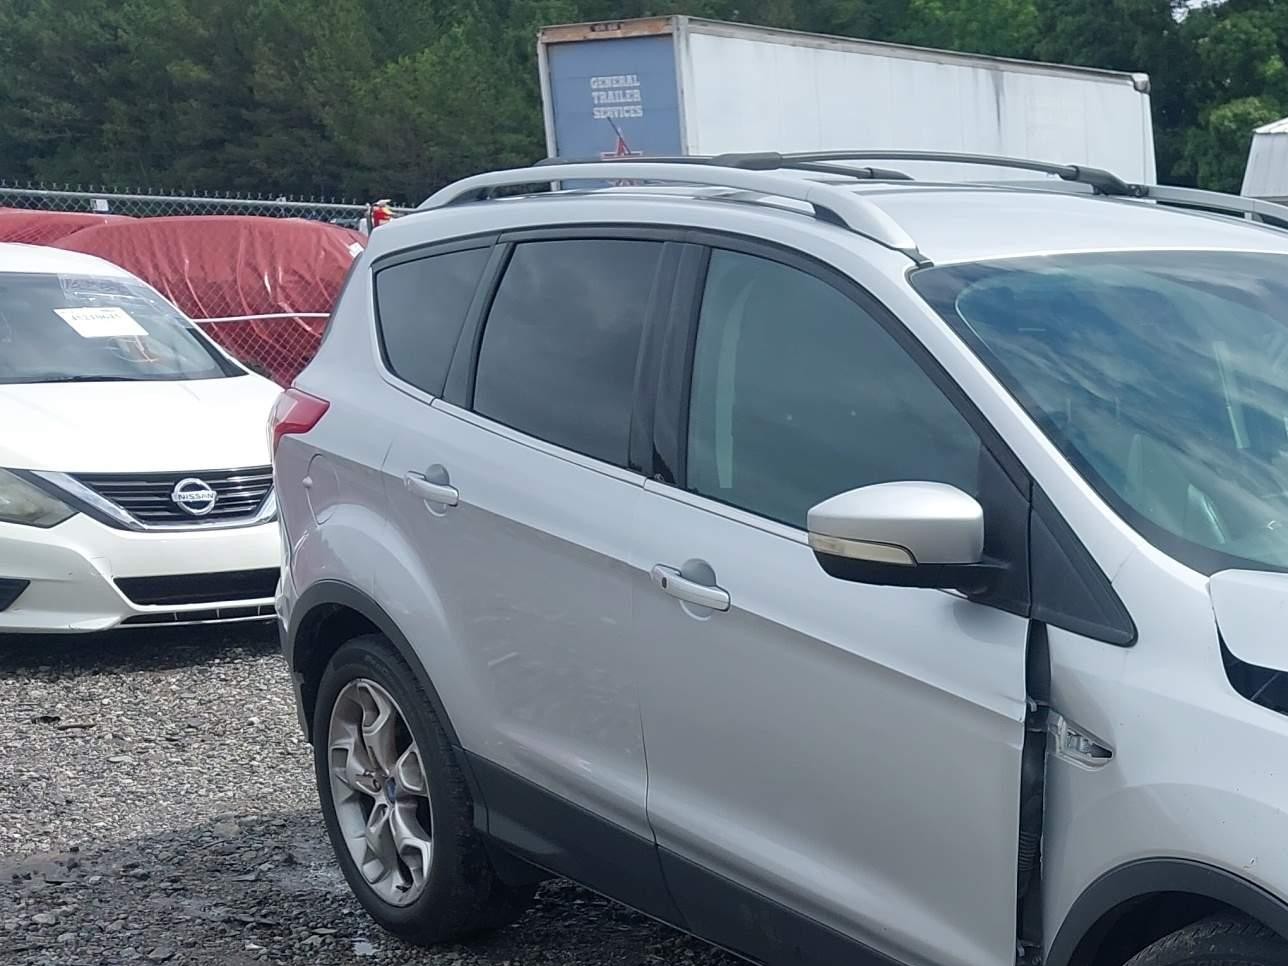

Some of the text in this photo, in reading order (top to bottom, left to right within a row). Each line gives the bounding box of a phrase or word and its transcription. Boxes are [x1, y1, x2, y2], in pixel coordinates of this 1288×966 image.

[591, 75, 640, 88] GENERAL
[592, 90, 641, 104] TRAILER
[593, 106, 643, 119] SERVICES
